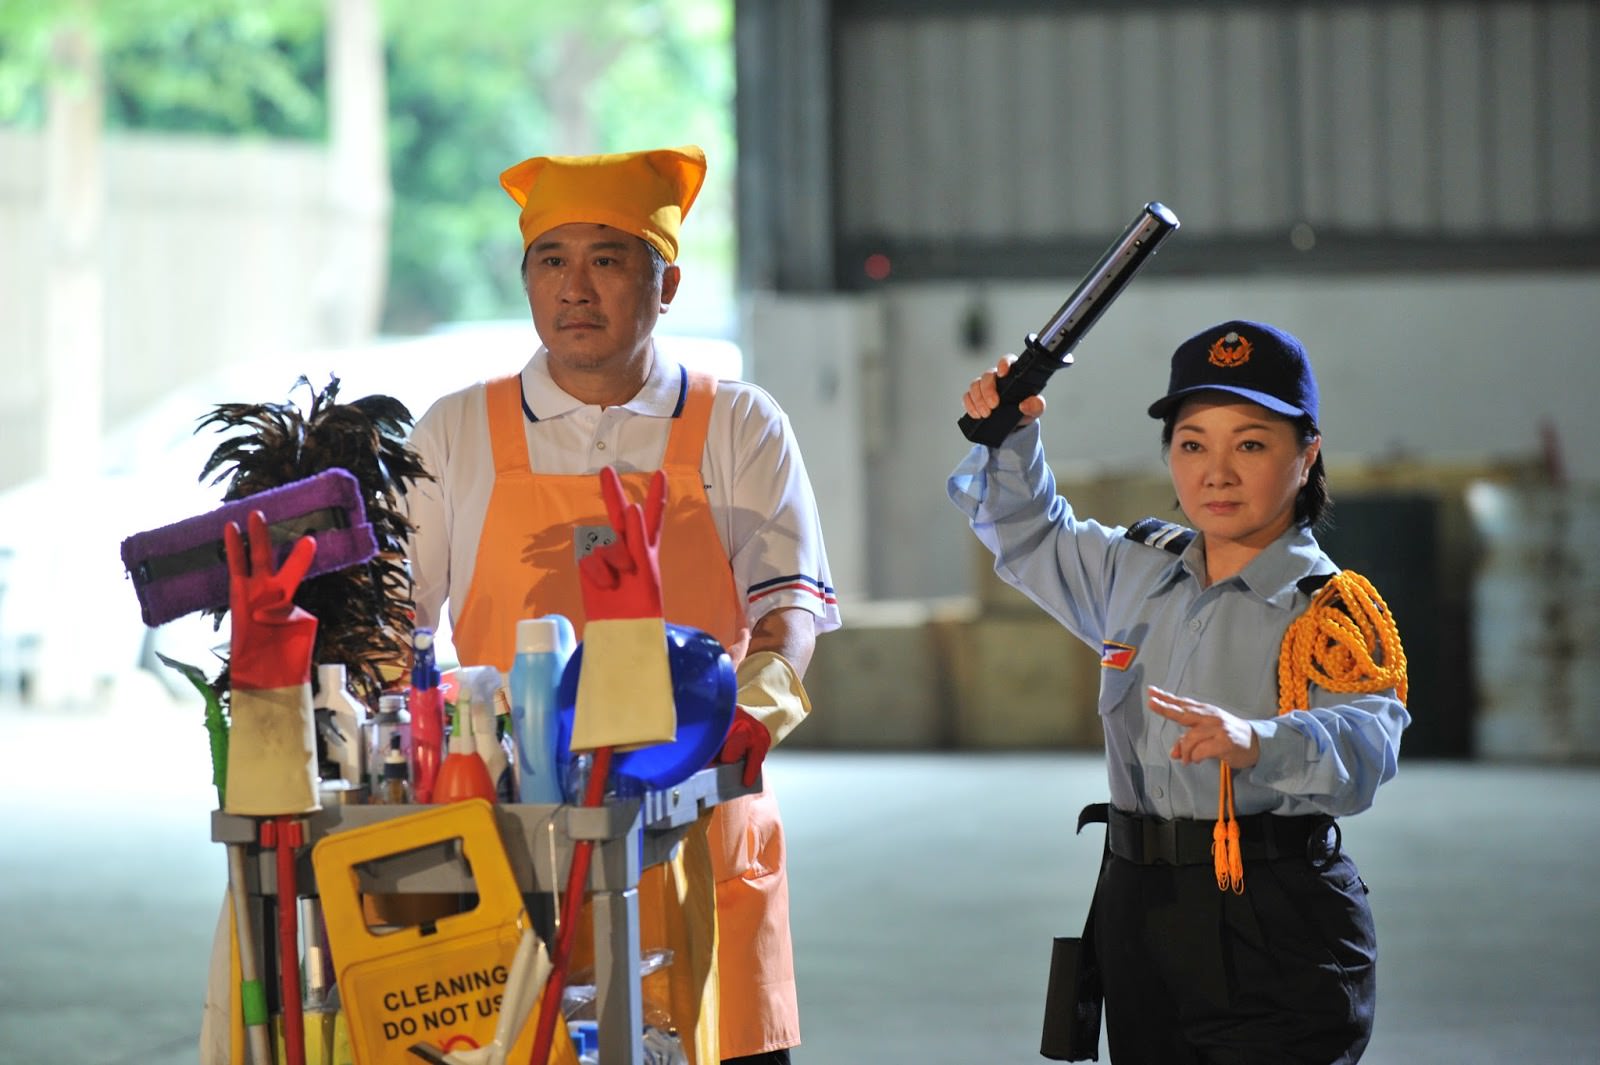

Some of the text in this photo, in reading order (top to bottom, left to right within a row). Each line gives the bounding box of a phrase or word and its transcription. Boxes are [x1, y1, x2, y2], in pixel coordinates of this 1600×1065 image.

[383, 965, 508, 1011] CLEANING
[383, 994, 503, 1040] DO NOT US
